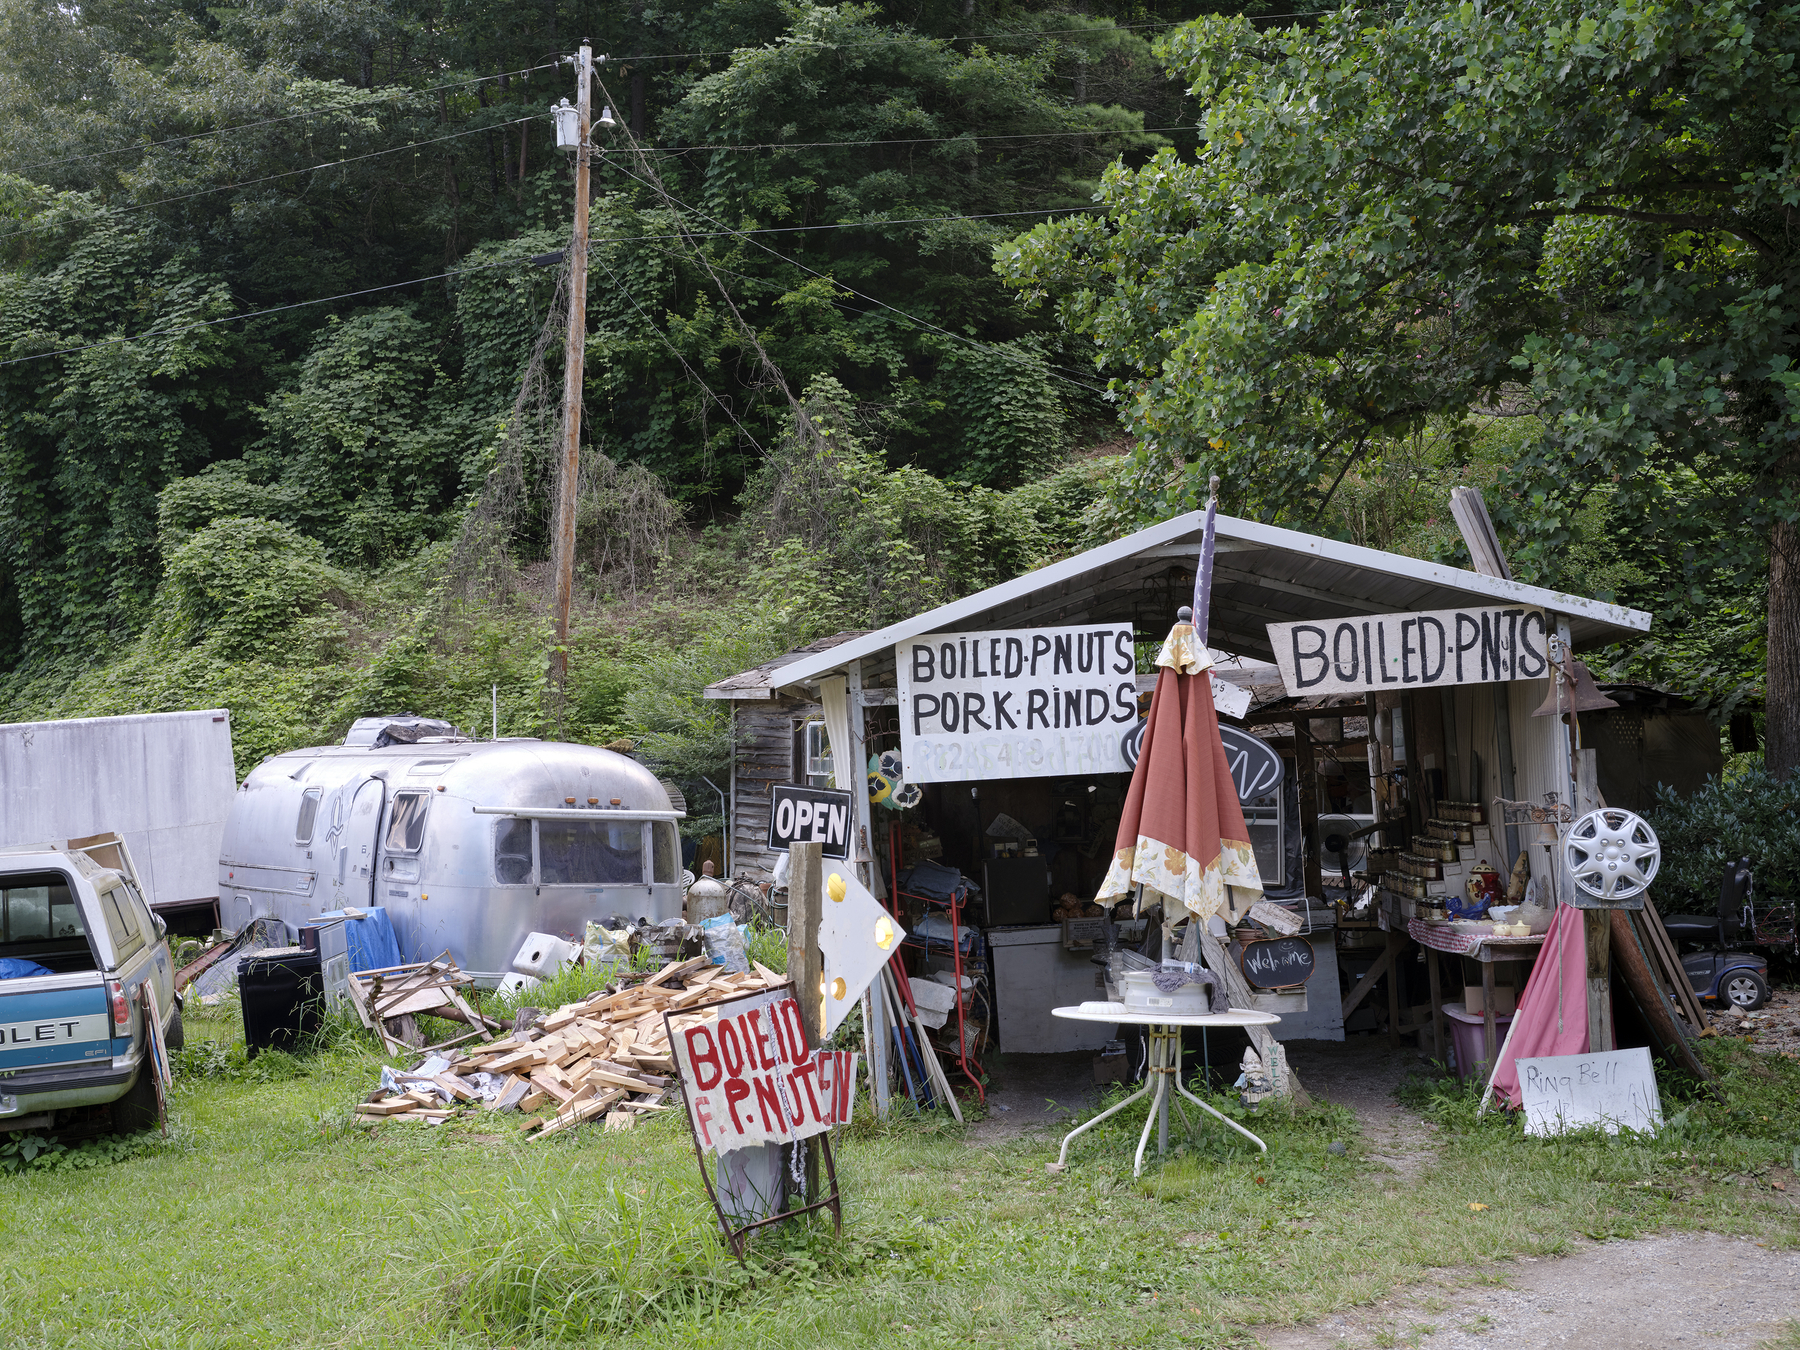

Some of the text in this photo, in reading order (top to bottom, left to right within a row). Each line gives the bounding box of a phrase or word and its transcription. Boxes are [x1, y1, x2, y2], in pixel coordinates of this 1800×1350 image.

[776, 798, 847, 845] OPEN
[84, 1049, 107, 1057] EFI
[1526, 1065, 1575, 1115] Ring
[1576, 1061, 1618, 1086] Bell
